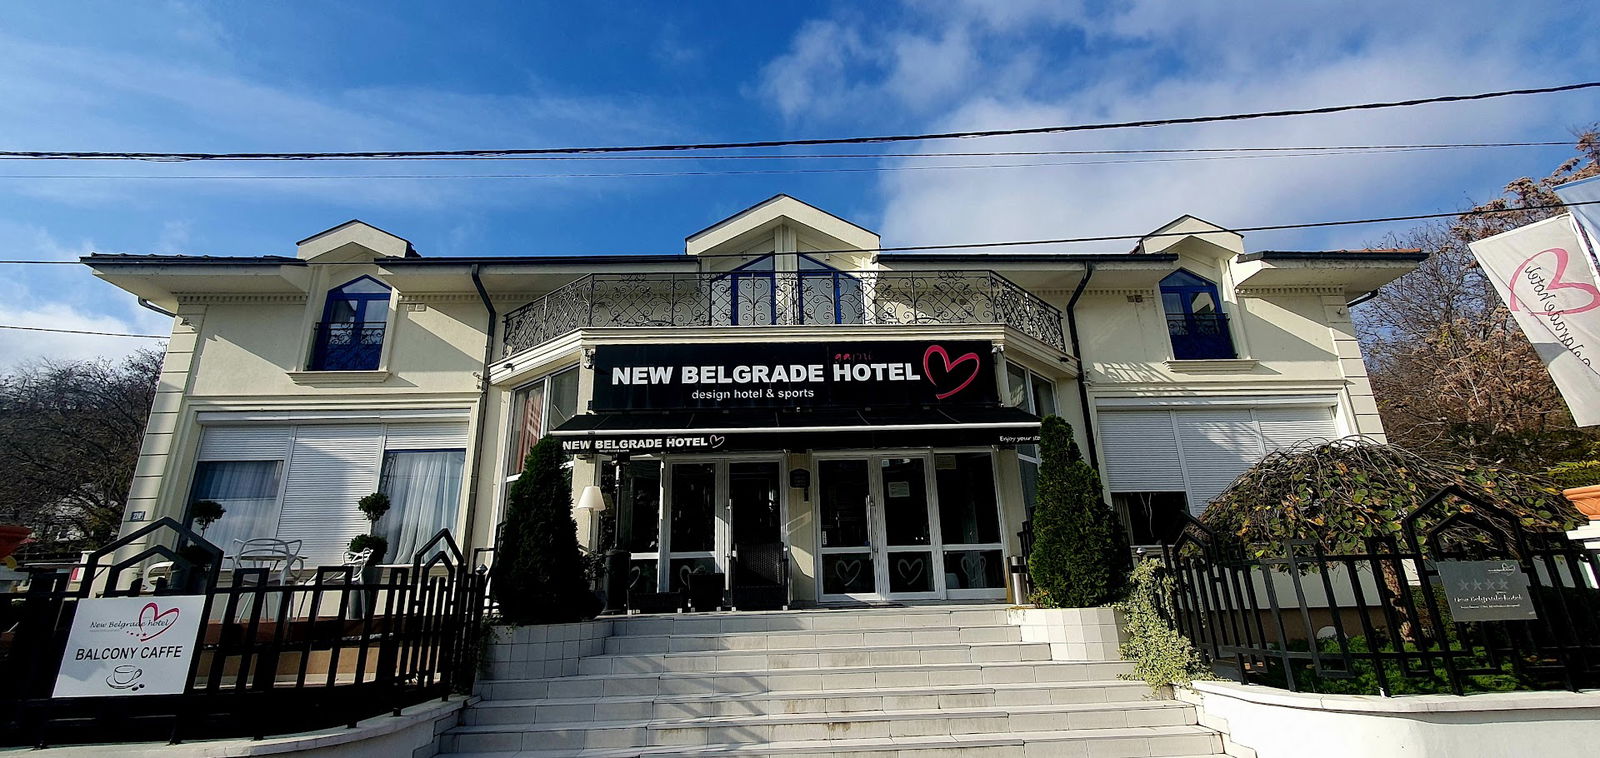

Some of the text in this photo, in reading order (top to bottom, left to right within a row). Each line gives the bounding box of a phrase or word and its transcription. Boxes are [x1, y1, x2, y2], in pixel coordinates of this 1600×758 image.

[611, 362, 921, 385] NEW BELGRADE HOTEL
[691, 387, 815, 401] design hotel & sports
[562, 437, 708, 450] NEW BELGRADE HOTEL
[89, 619, 170, 630] New Belgrade hotel
[75, 645, 183, 660] BALCONY CAFFE
